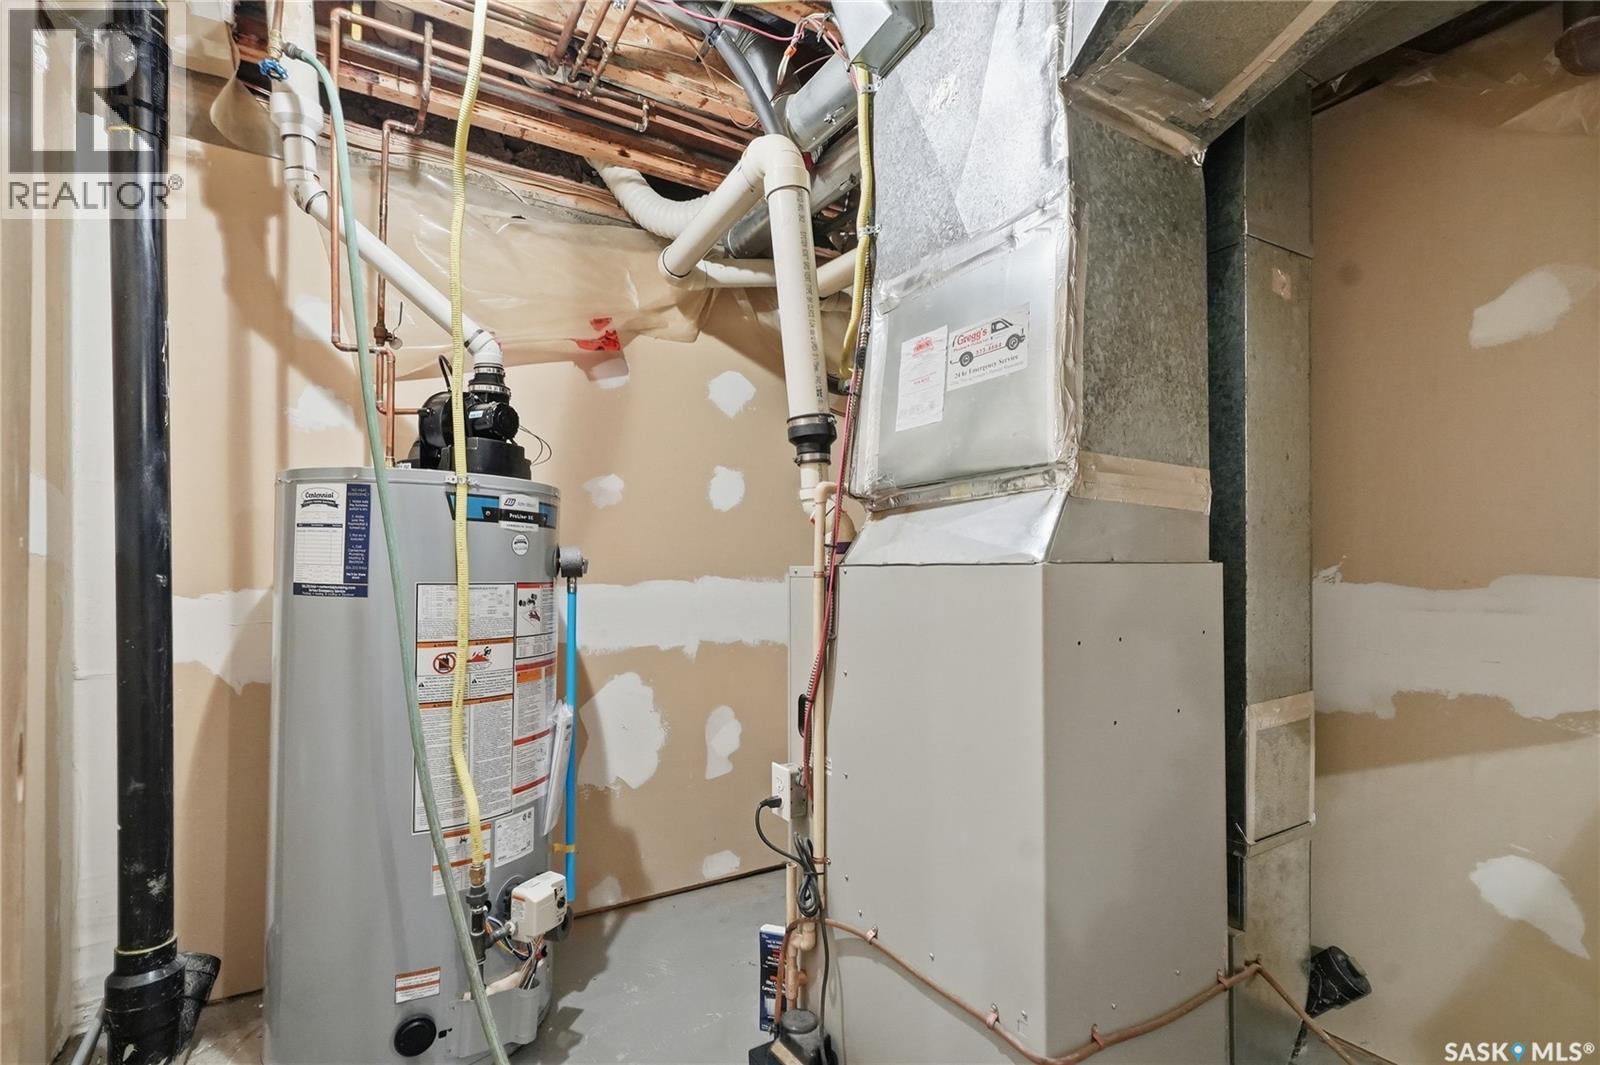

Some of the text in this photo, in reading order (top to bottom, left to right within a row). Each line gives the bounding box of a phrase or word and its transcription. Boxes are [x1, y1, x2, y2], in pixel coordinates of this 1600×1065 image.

[957, 327, 987, 345] Gregg's
[969, 362, 997, 374] Emergency
[999, 355, 1018, 364] Service
